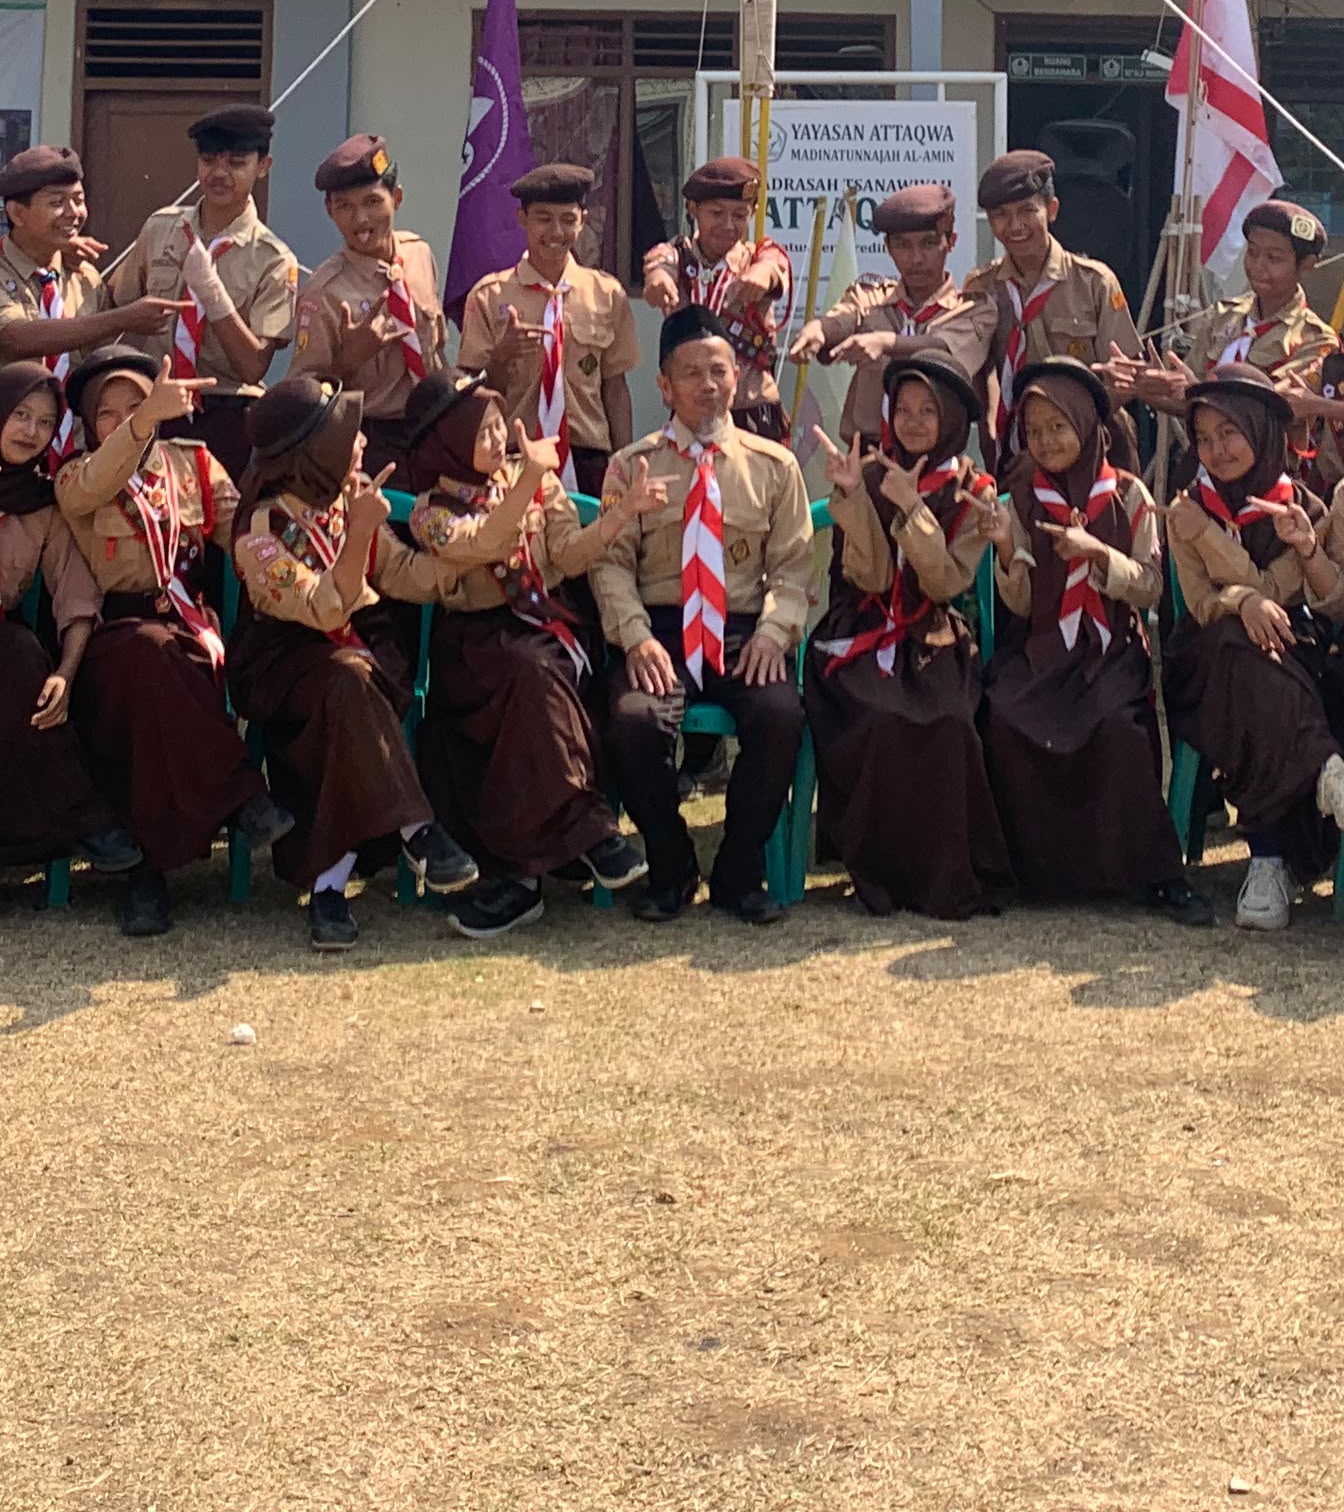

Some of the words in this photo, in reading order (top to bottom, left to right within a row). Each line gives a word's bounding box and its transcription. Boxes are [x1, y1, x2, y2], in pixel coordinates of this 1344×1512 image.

[791, 123, 865, 141] YAYASAN
[870, 124, 954, 146] ATTAQWA
[791, 148, 900, 165] MADINATUNNAJAH
[903, 150, 954, 163] AL-AMIN
